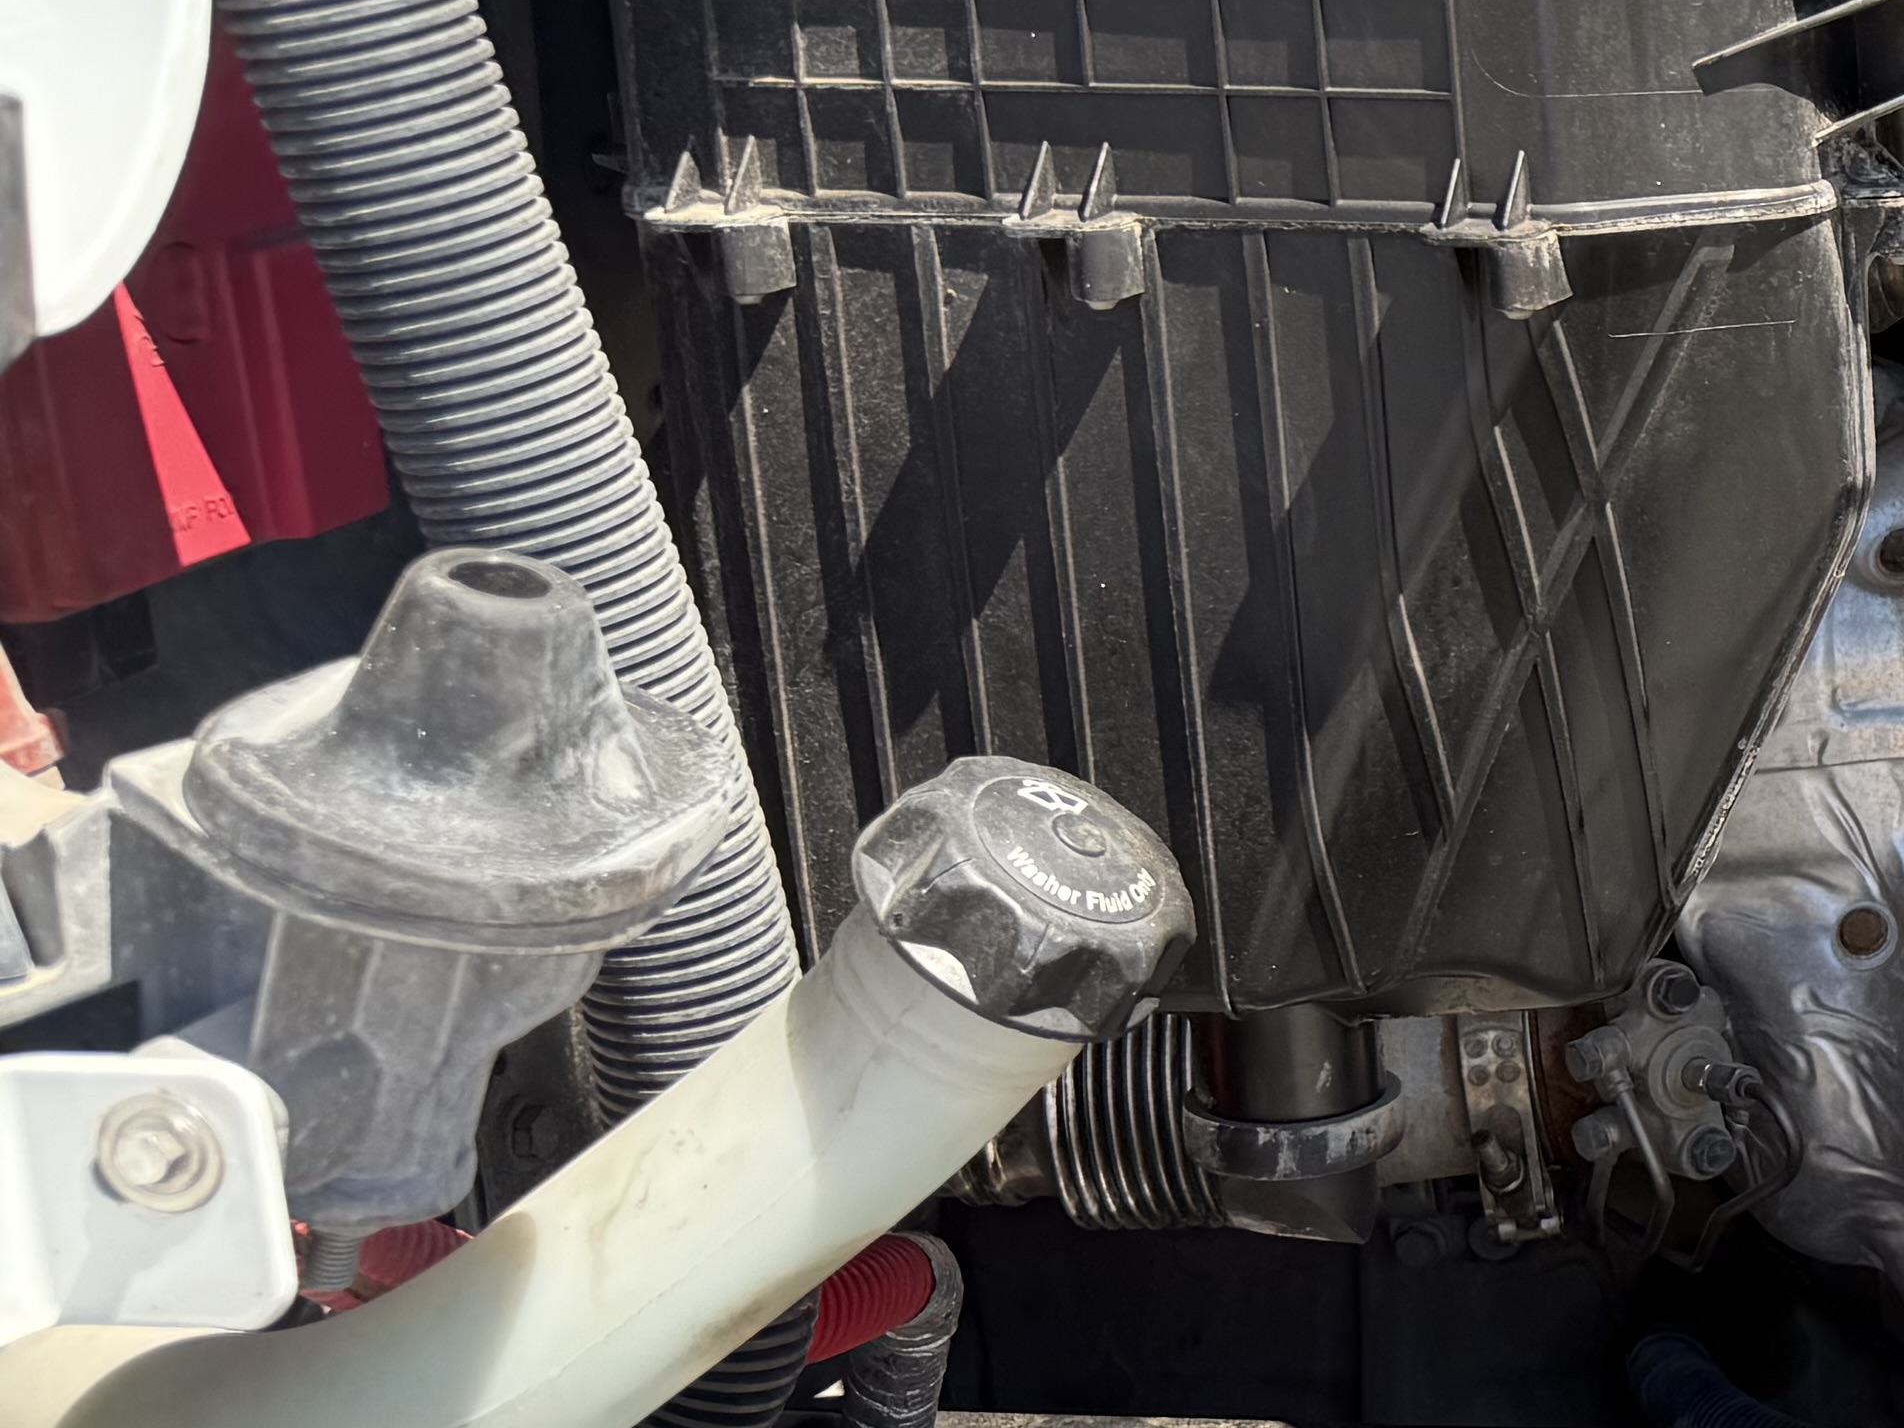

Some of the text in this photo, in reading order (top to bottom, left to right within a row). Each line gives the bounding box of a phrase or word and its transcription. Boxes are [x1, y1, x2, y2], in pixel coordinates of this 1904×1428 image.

[1007, 845, 1156, 913] Washer Fluid Only
